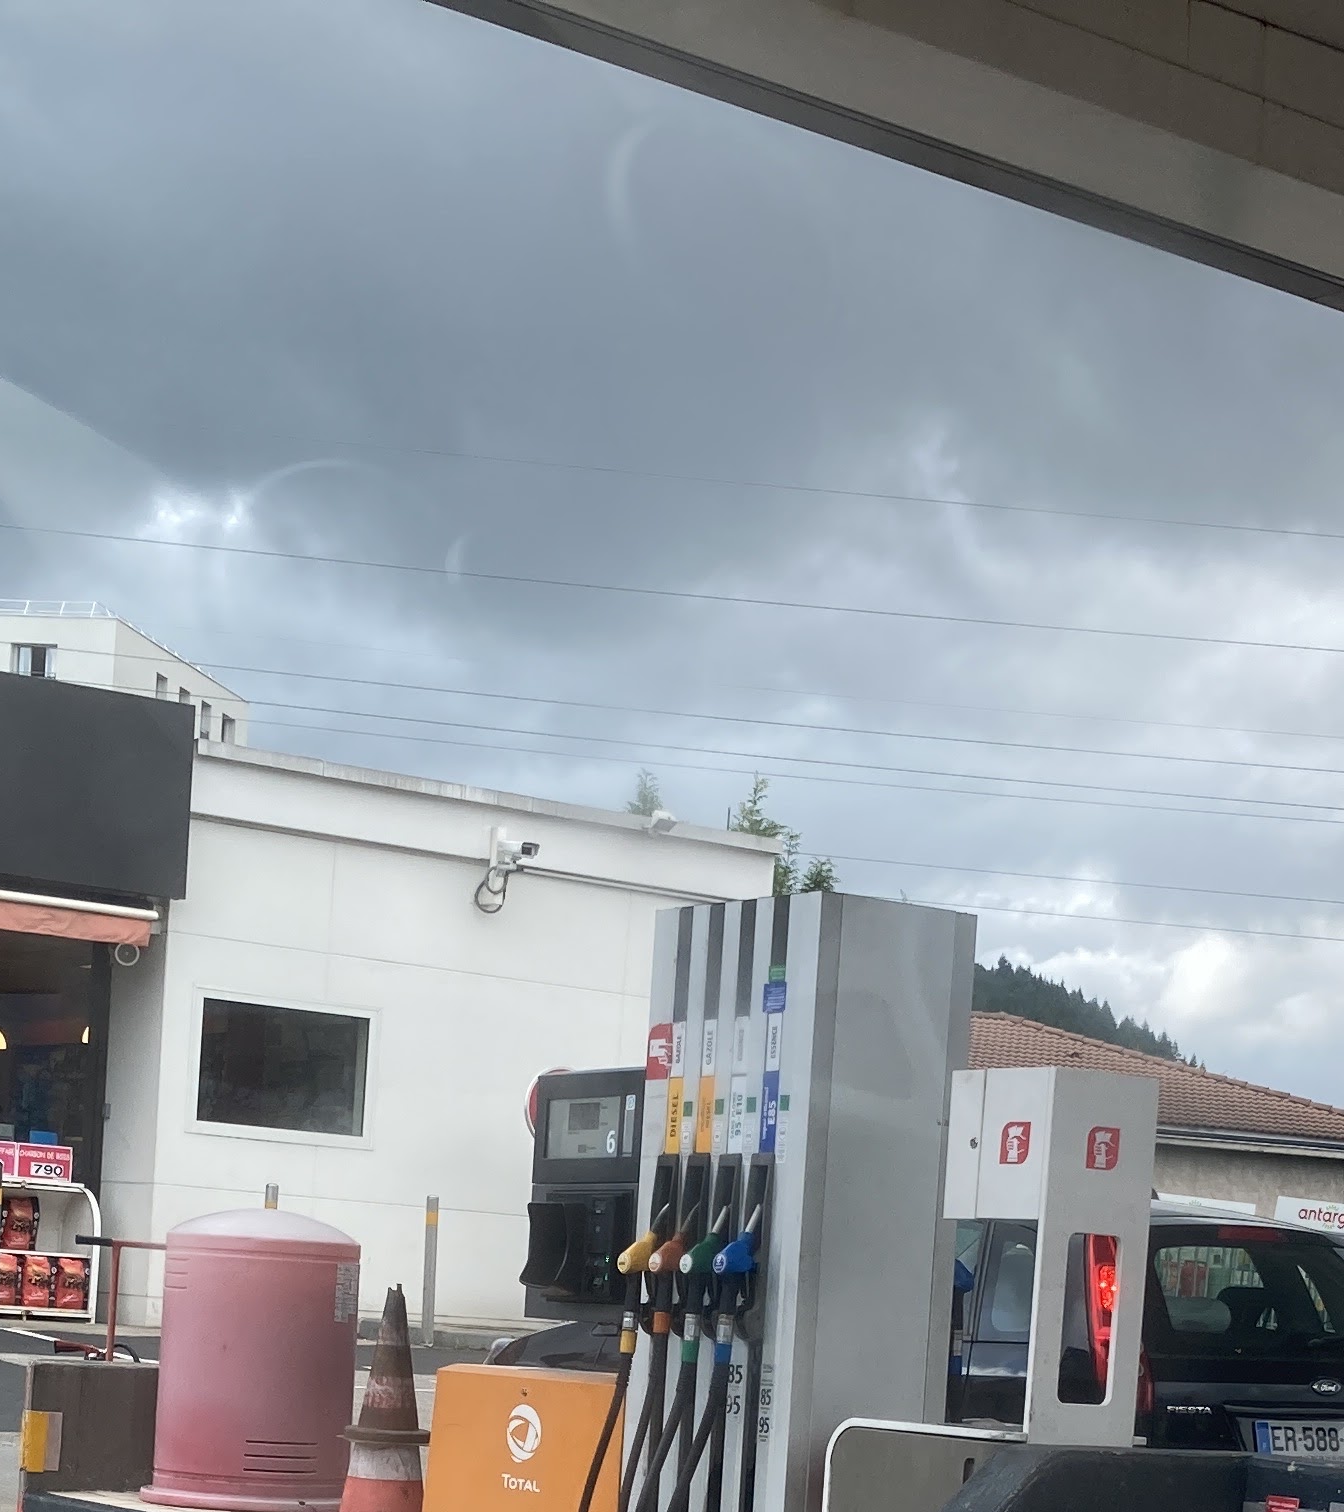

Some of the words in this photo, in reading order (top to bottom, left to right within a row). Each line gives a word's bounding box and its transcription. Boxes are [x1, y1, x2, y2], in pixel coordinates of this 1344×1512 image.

[705, 1030, 713, 1066] GAZOLE
[669, 1094, 679, 1138] DIESEL
[734, 1094, 744, 1136] 95-E10
[767, 1100, 777, 1125] E85
[606, 1130, 616, 1154] 6
[47, 1151, 55, 1160] DE
[727, 1364, 743, 1384] 85
[760, 1389, 772, 1406] 85
[1320, 1383, 1338, 1393] Ford
[1166, 1405, 1212, 1415] FIESTA
[759, 1416, 770, 1434] 95
[501, 1473, 541, 1493] TOTAL
